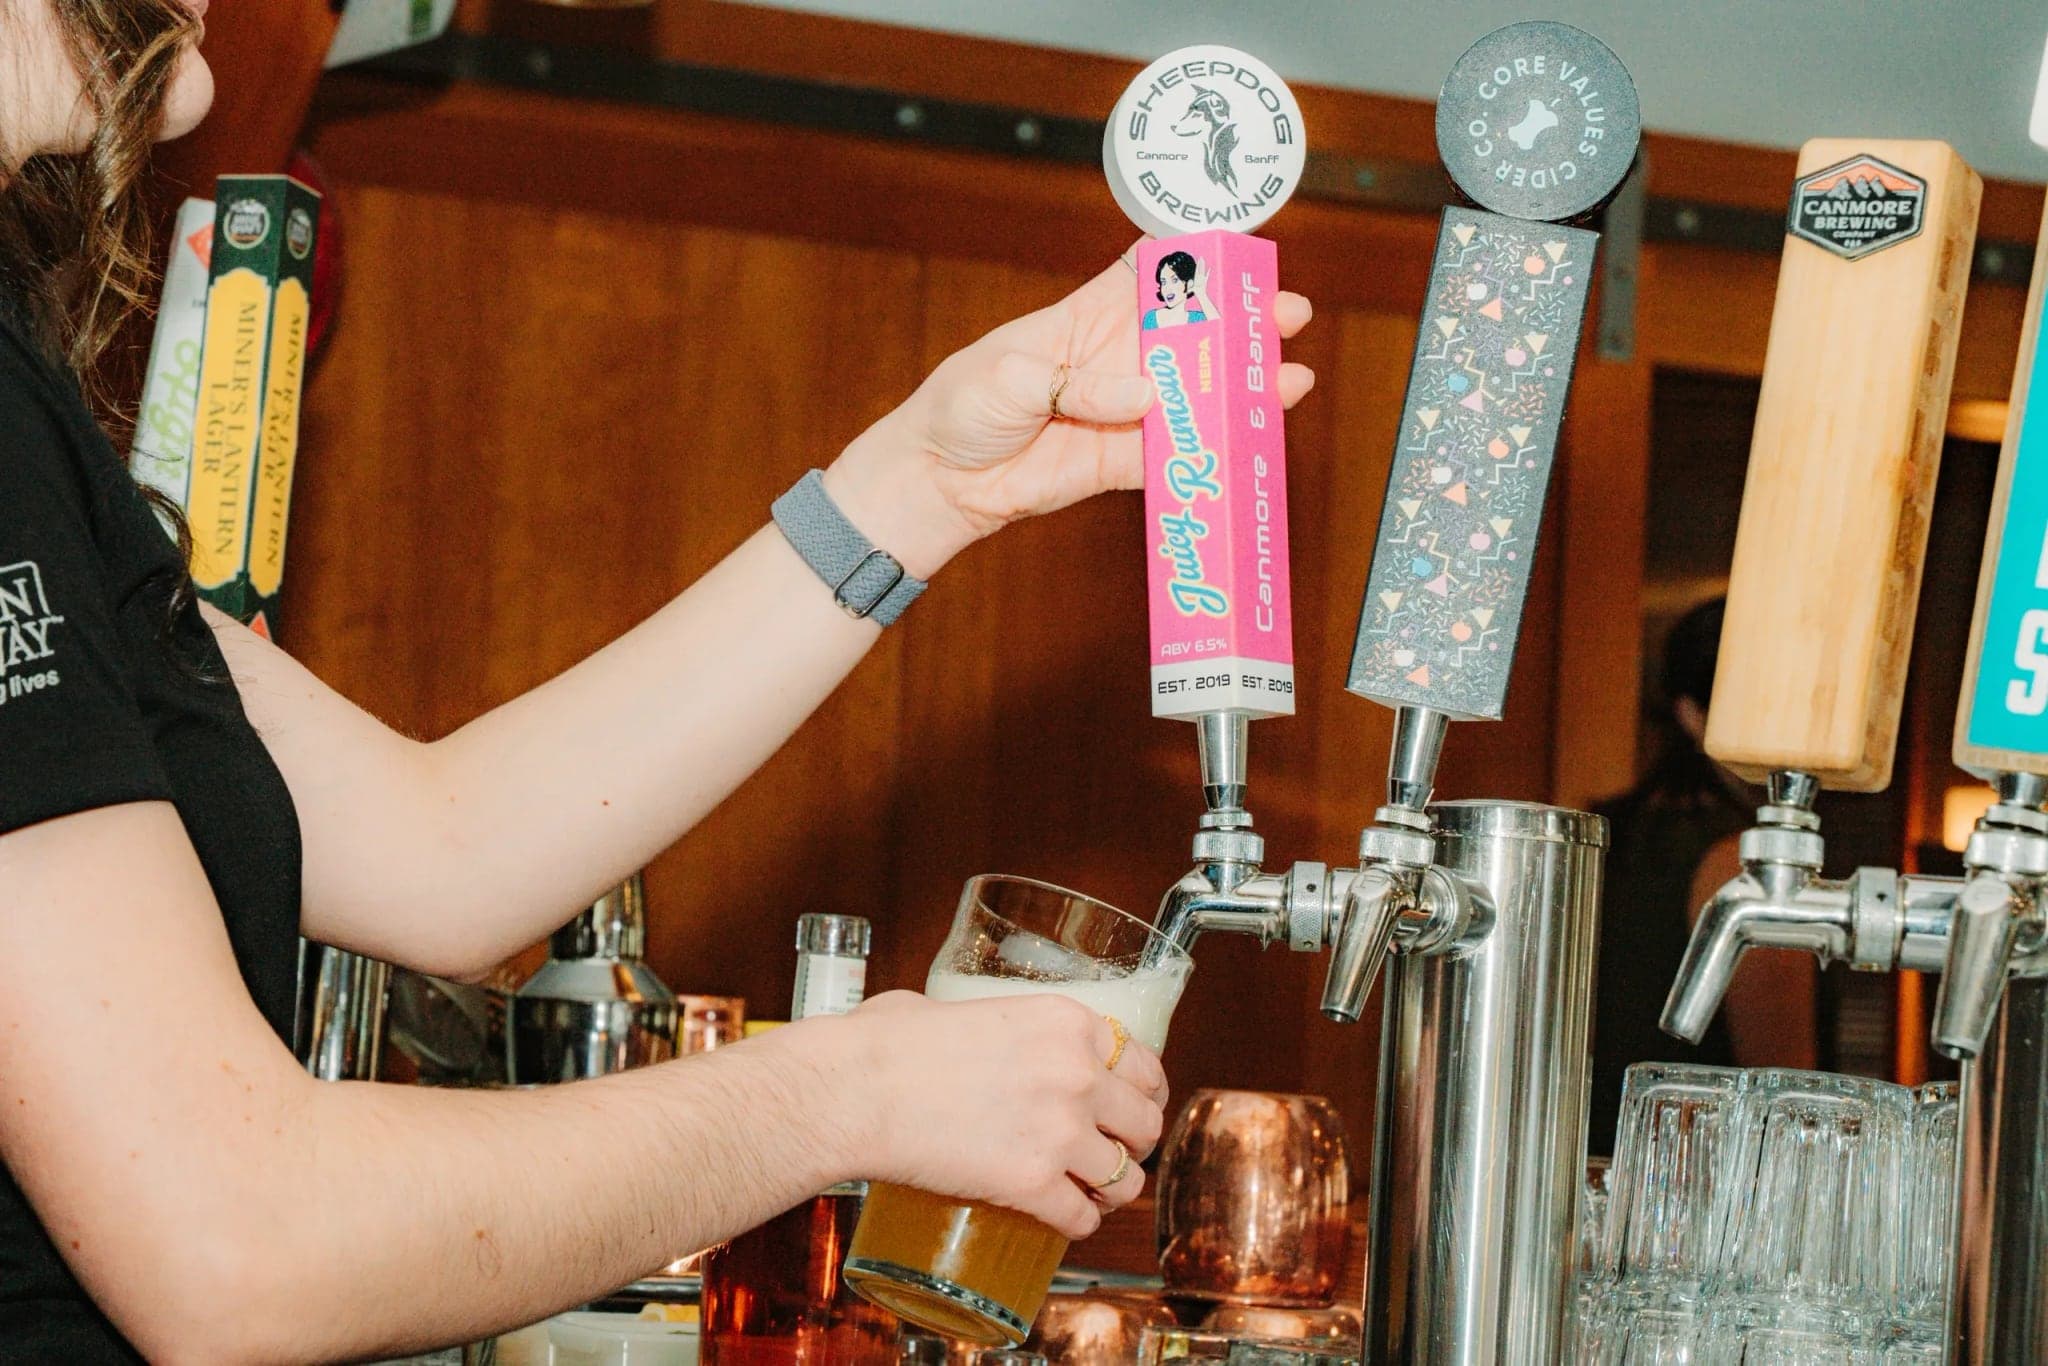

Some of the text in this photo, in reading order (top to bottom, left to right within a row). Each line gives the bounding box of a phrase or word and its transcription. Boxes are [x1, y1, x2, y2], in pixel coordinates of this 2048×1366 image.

[1129, 61, 1293, 145] SHEEPDOG
[1478, 55, 1606, 157] CORE VALUES
[1136, 151, 1189, 161] Canmore
[1244, 154, 1279, 164] Banff
[1468, 111, 1577, 189] CIDER CO.
[1138, 170, 1284, 224] BREWING
[1804, 200, 1913, 215] CANMORE
[1814, 217, 1898, 229] BREWING
[1241, 271, 1265, 393] Banff
[1198, 336, 1212, 393] NEIPA
[202, 383, 230, 473] LAGER
[216, 424, 246, 554] LANTERN
[1147, 344, 1228, 616] Juicy Rumour
[1253, 454, 1274, 633] Canmore
[1161, 637, 1228, 657] ABV 6.5%
[9, 669, 61, 698] lives
[1158, 673, 1231, 695] EST. 2019
[1242, 674, 1293, 694] EST. 2019
